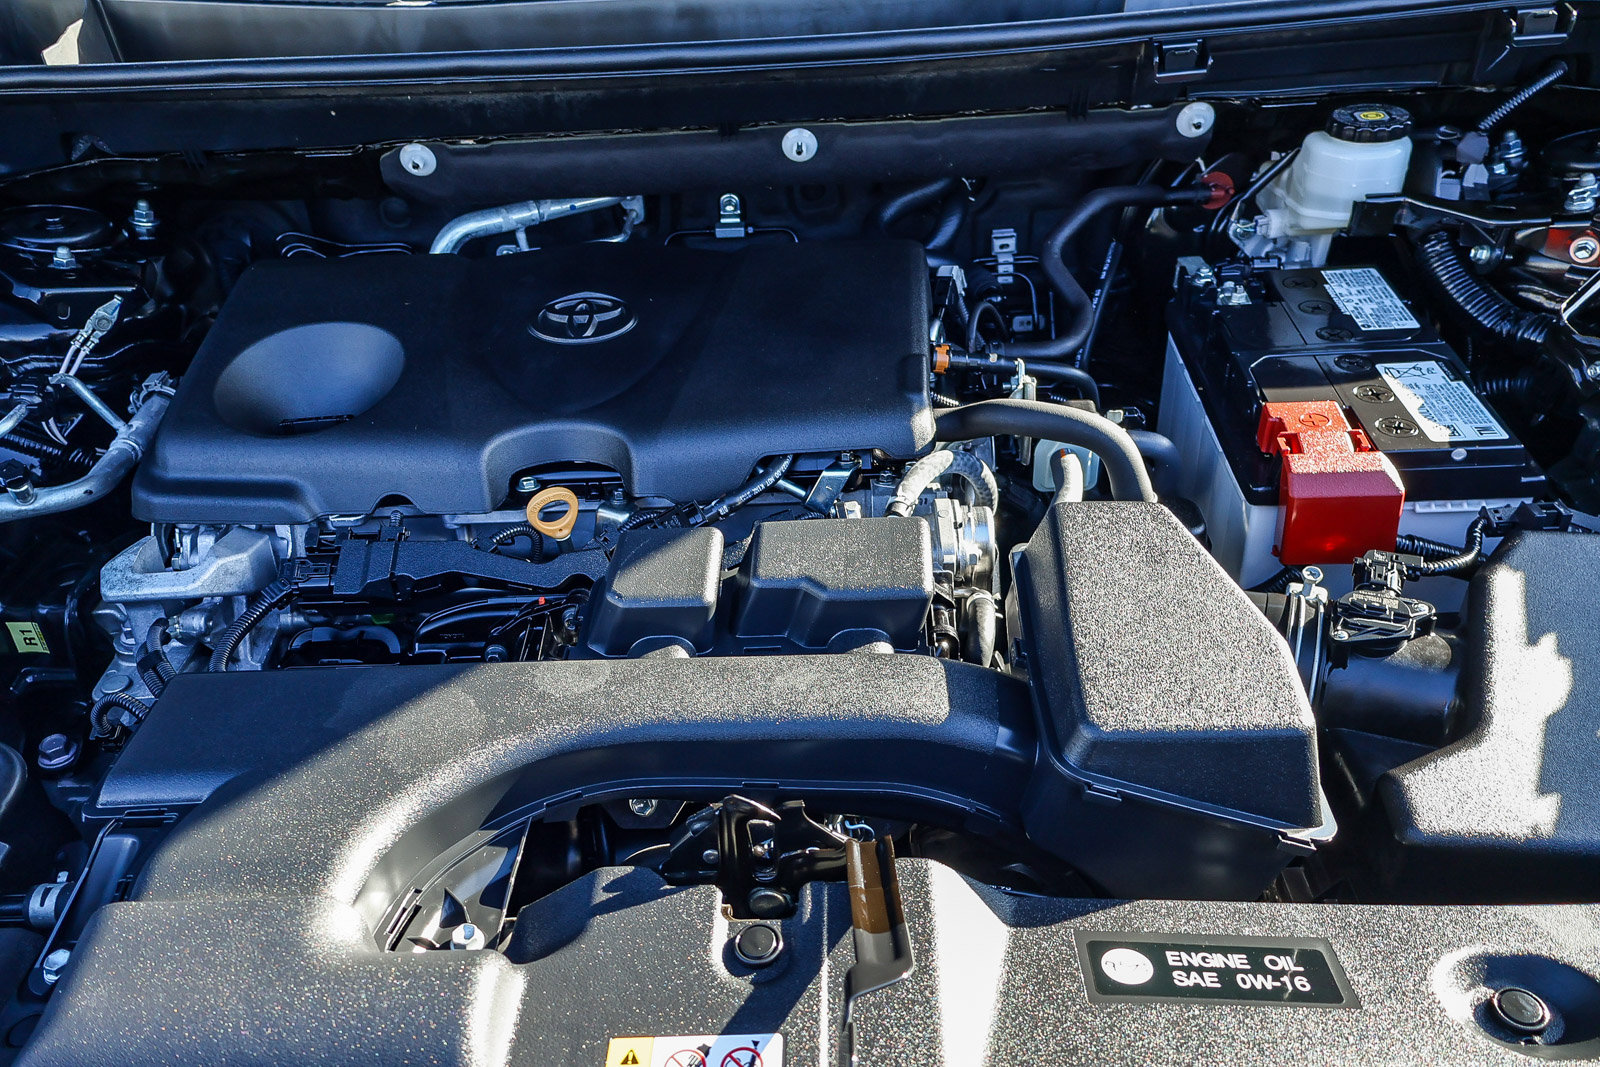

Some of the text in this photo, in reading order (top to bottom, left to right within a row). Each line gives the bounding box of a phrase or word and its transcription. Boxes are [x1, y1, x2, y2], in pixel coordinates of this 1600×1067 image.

[19, 630, 38, 646] R1
[1165, 950, 1305, 972] ENGINE OIL
[1172, 971, 1312, 992] SAE 0W-16
